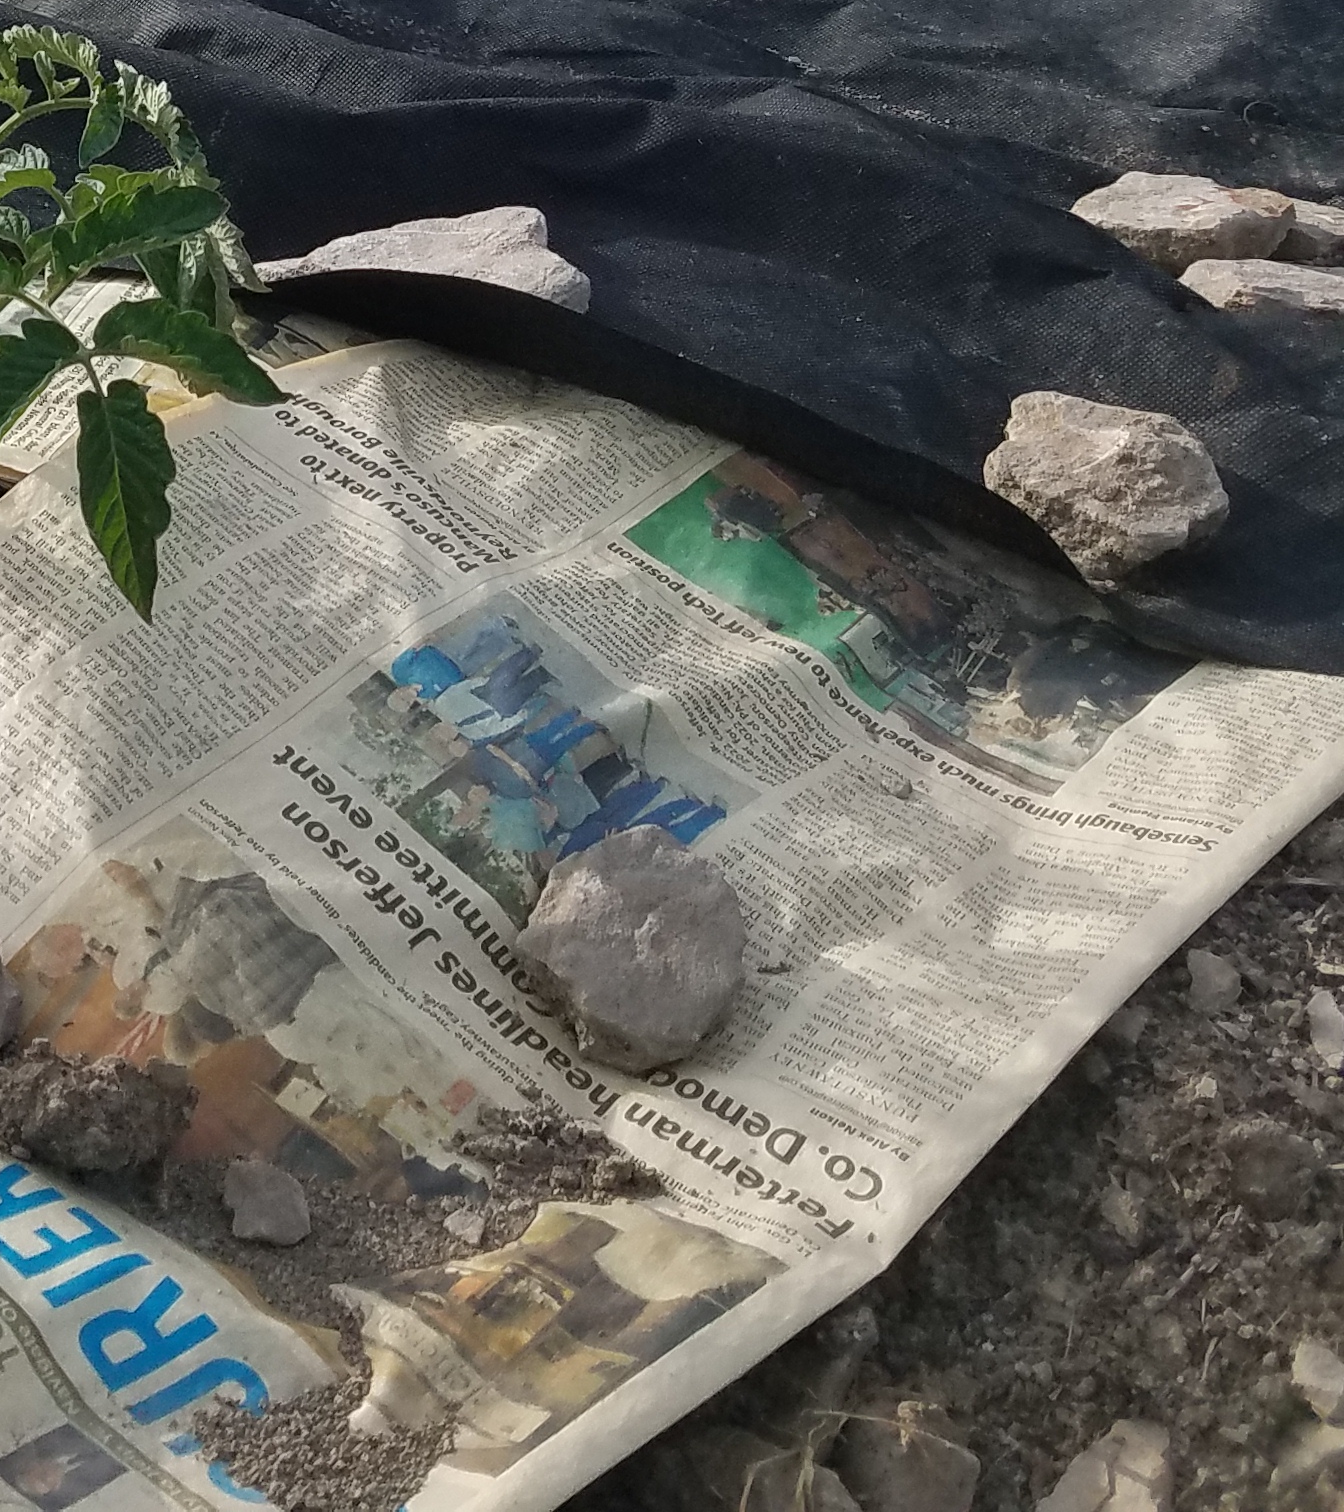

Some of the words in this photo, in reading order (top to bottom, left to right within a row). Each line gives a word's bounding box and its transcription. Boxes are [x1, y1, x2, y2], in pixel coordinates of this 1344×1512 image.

[272, 405, 300, 430] to
[285, 385, 383, 453] Borough
[298, 422, 392, 483] donated
[298, 452, 327, 476] to
[324, 466, 382, 504] next
[380, 445, 518, 562] Reynoldsville
[376, 495, 479, 574] Property
[389, 480, 500, 568] Mancuso's
[604, 539, 684, 595] position
[679, 588, 725, 626] Tech
[721, 615, 766, 646] Jeff
[765, 632, 812, 667] new
[806, 660, 831, 688] to
[824, 683, 936, 763] experience
[270, 741, 374, 831] event
[935, 757, 999, 799] much
[997, 785, 1075, 824] brings
[1074, 800, 1212, 852] Sensebaugh
[279, 798, 441, 955] Jefferson
[432, 949, 615, 1118] headlines
[808, 1105, 857, 1136] Nelson
[856, 1129, 890, 1152] Alex
[621, 1098, 854, 1242] Fetterman
[808, 1144, 886, 1207] Co.
